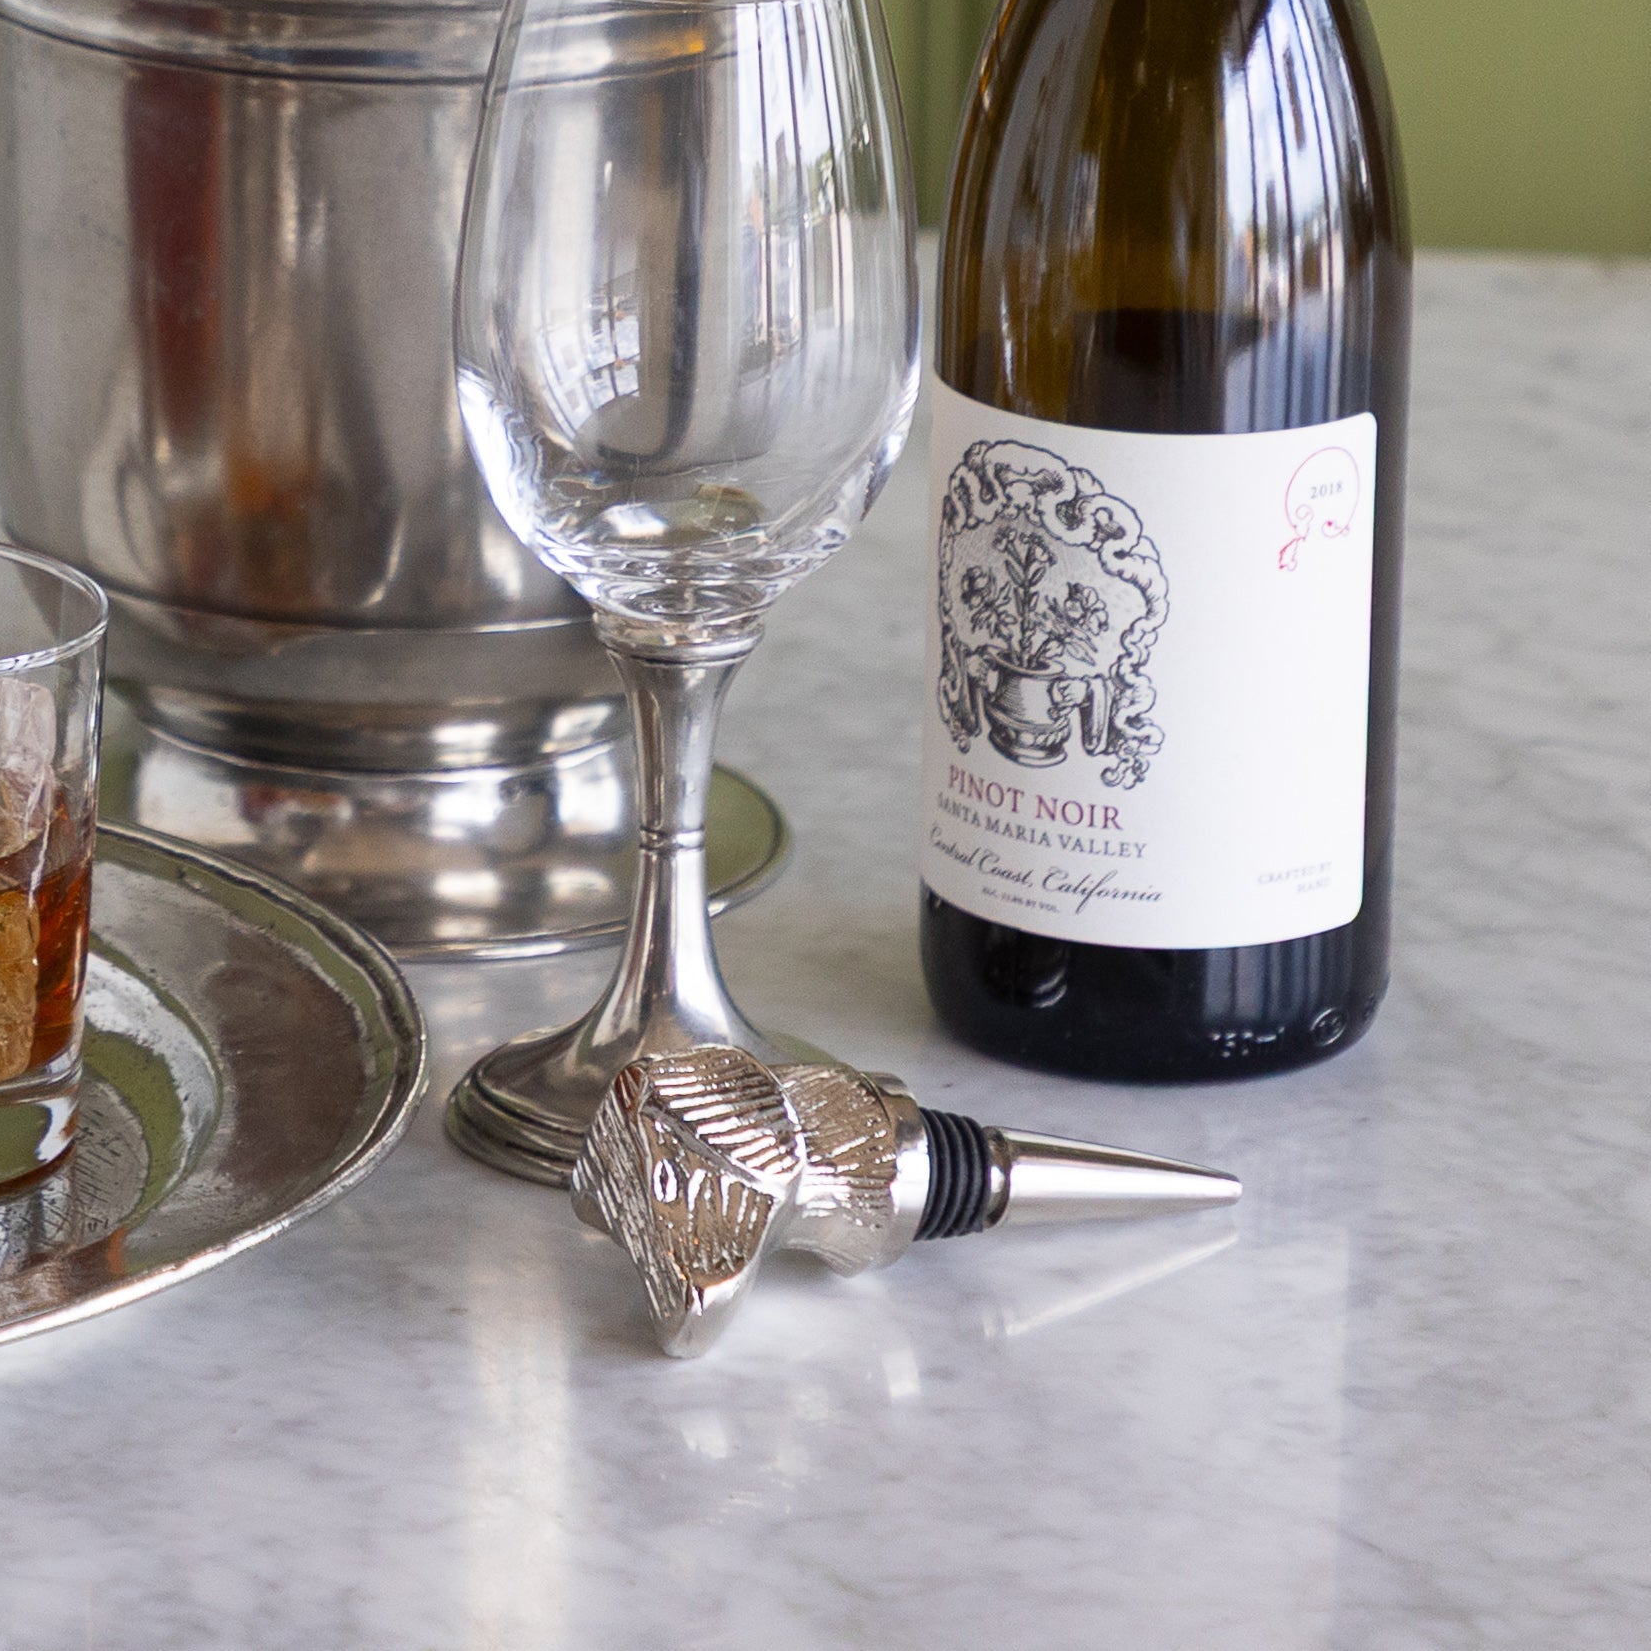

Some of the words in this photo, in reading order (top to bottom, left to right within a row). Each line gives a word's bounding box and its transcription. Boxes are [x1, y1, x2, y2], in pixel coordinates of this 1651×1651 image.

[1310, 481, 1343, 499] 2018
[937, 791, 981, 828] SANTA
[985, 815, 1052, 848] MARIA
[1057, 833, 1147, 859] VALLEY
[948, 764, 1024, 814] PINOT
[1035, 794, 1123, 830] NOIR
[930, 826, 980, 867] Central
[978, 849, 1034, 888] Coast,
[1041, 866, 1164, 915] California
